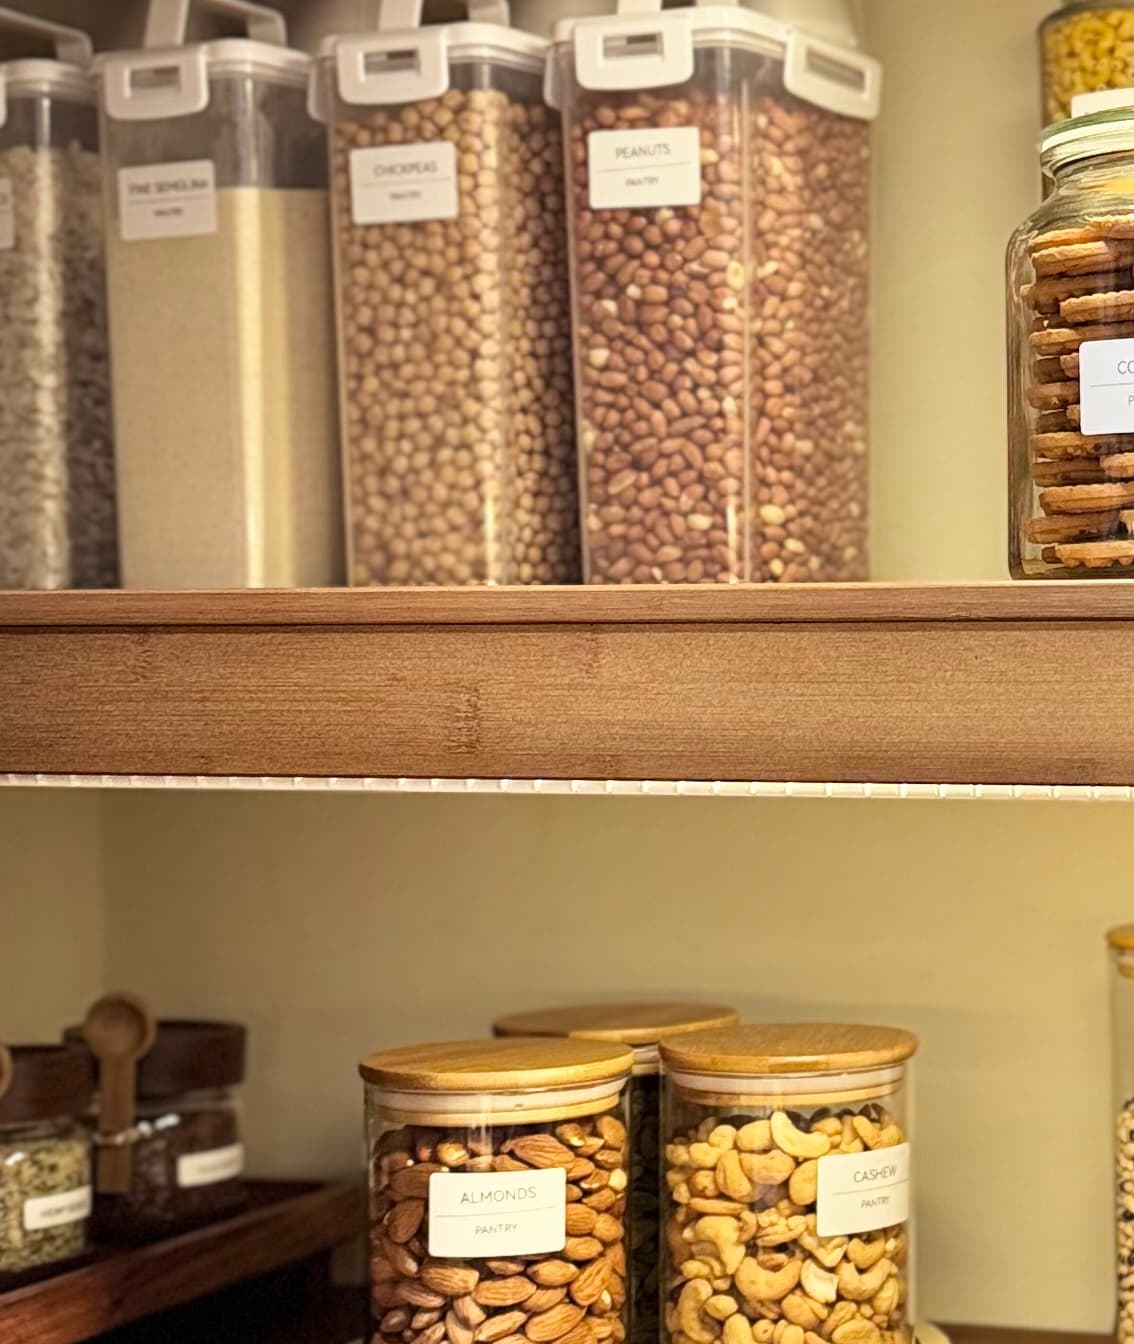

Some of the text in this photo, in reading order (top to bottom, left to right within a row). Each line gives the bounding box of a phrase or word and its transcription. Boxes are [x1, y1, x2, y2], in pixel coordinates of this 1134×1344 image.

[615, 143, 672, 160] PEANUTS
[373, 160, 438, 179] CHICKPEAS
[625, 176, 659, 188] PANTRY
[388, 190, 422, 202] PANTRY
[852, 1165, 898, 1184] CASHEW
[460, 1186, 537, 1205] ALMONDS
[860, 1196, 891, 1209] PANTRY
[474, 1223, 518, 1236] PANTRY
